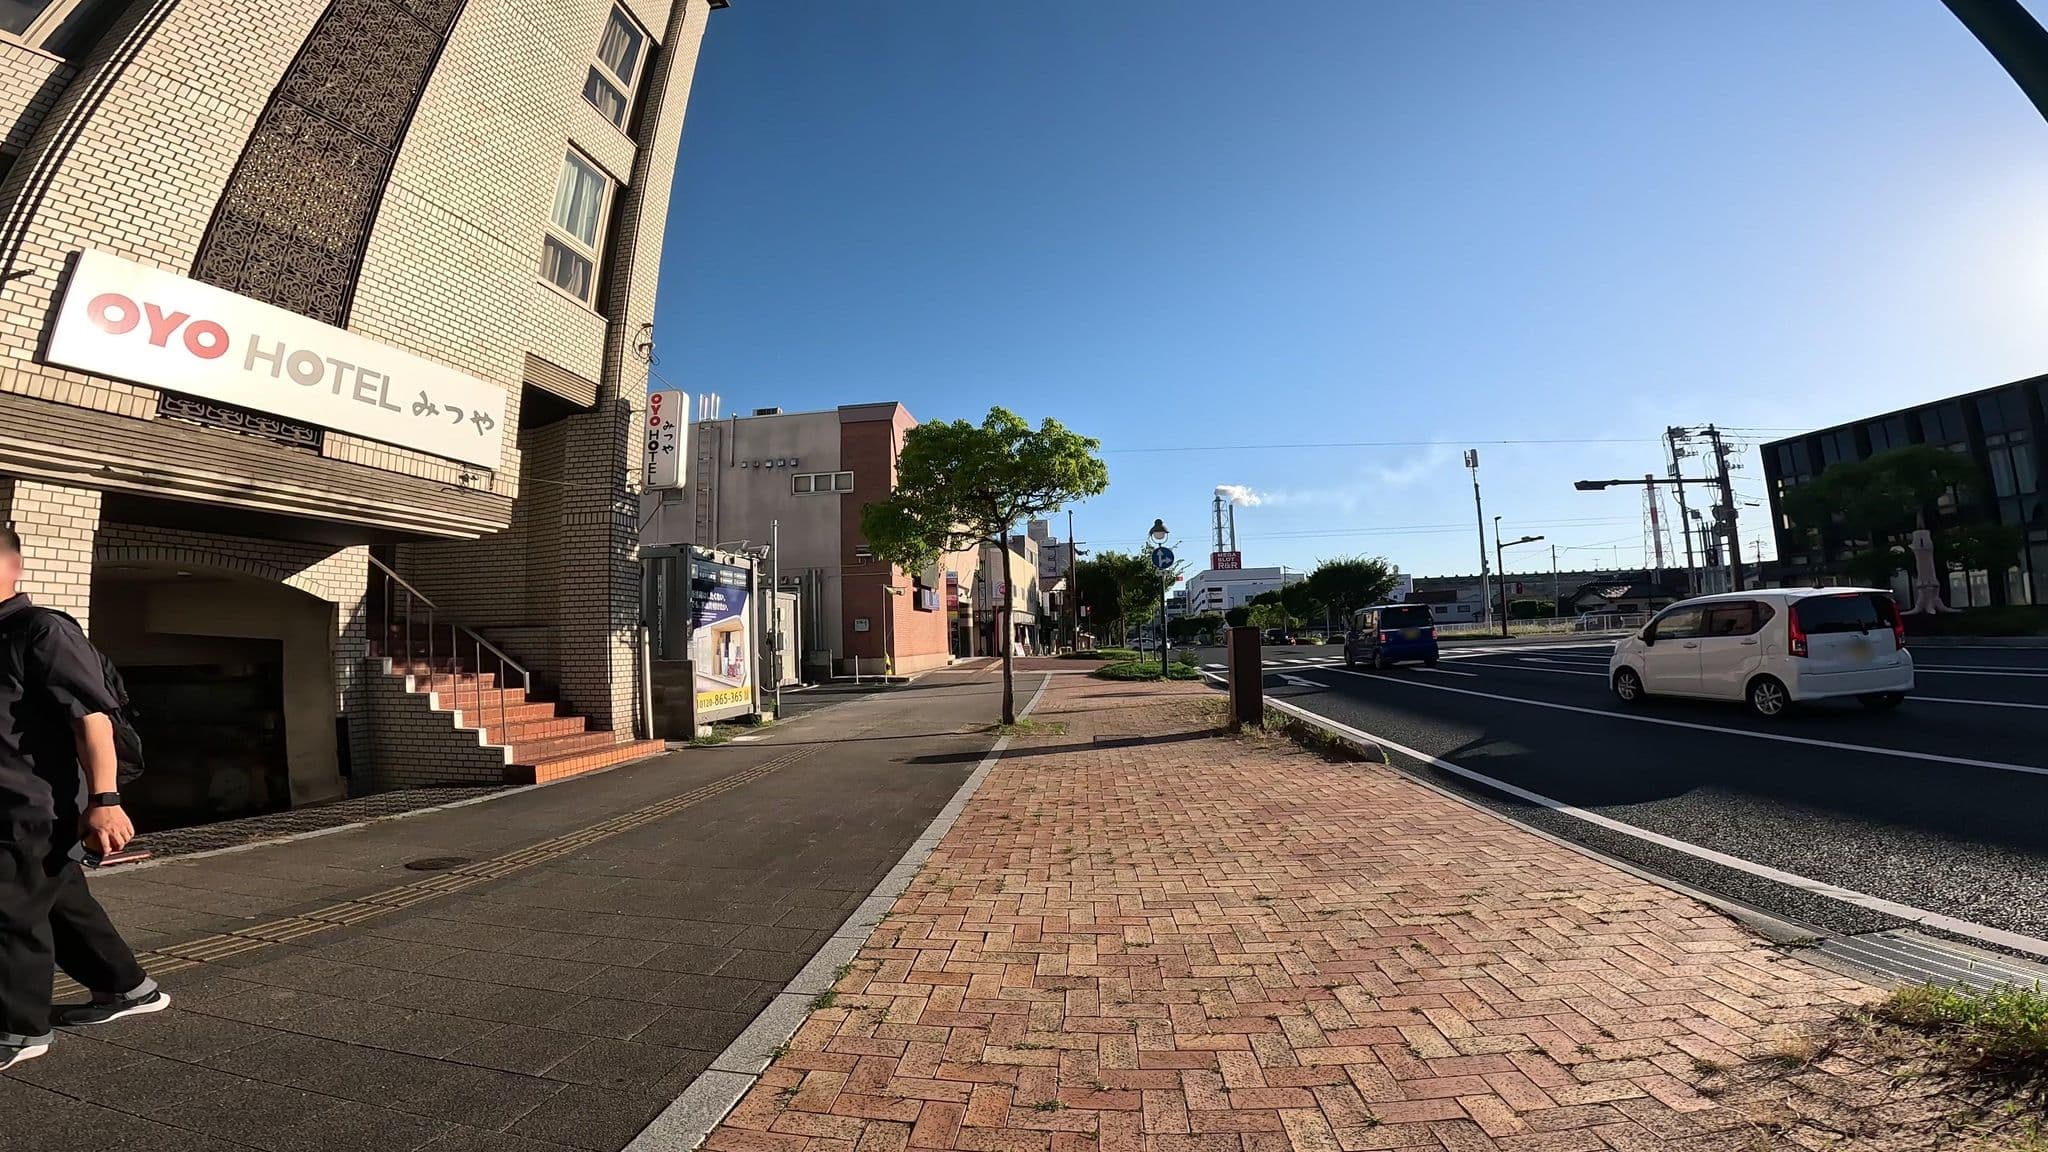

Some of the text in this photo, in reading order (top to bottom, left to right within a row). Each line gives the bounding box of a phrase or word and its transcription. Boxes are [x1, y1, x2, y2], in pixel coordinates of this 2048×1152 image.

[87, 293, 495, 436] OYO HOTEL みつや
[647, 393, 663, 486] OYO HOTEL
[661, 420, 675, 455] みつや
[699, 690, 743, 709] 0120-865-365
